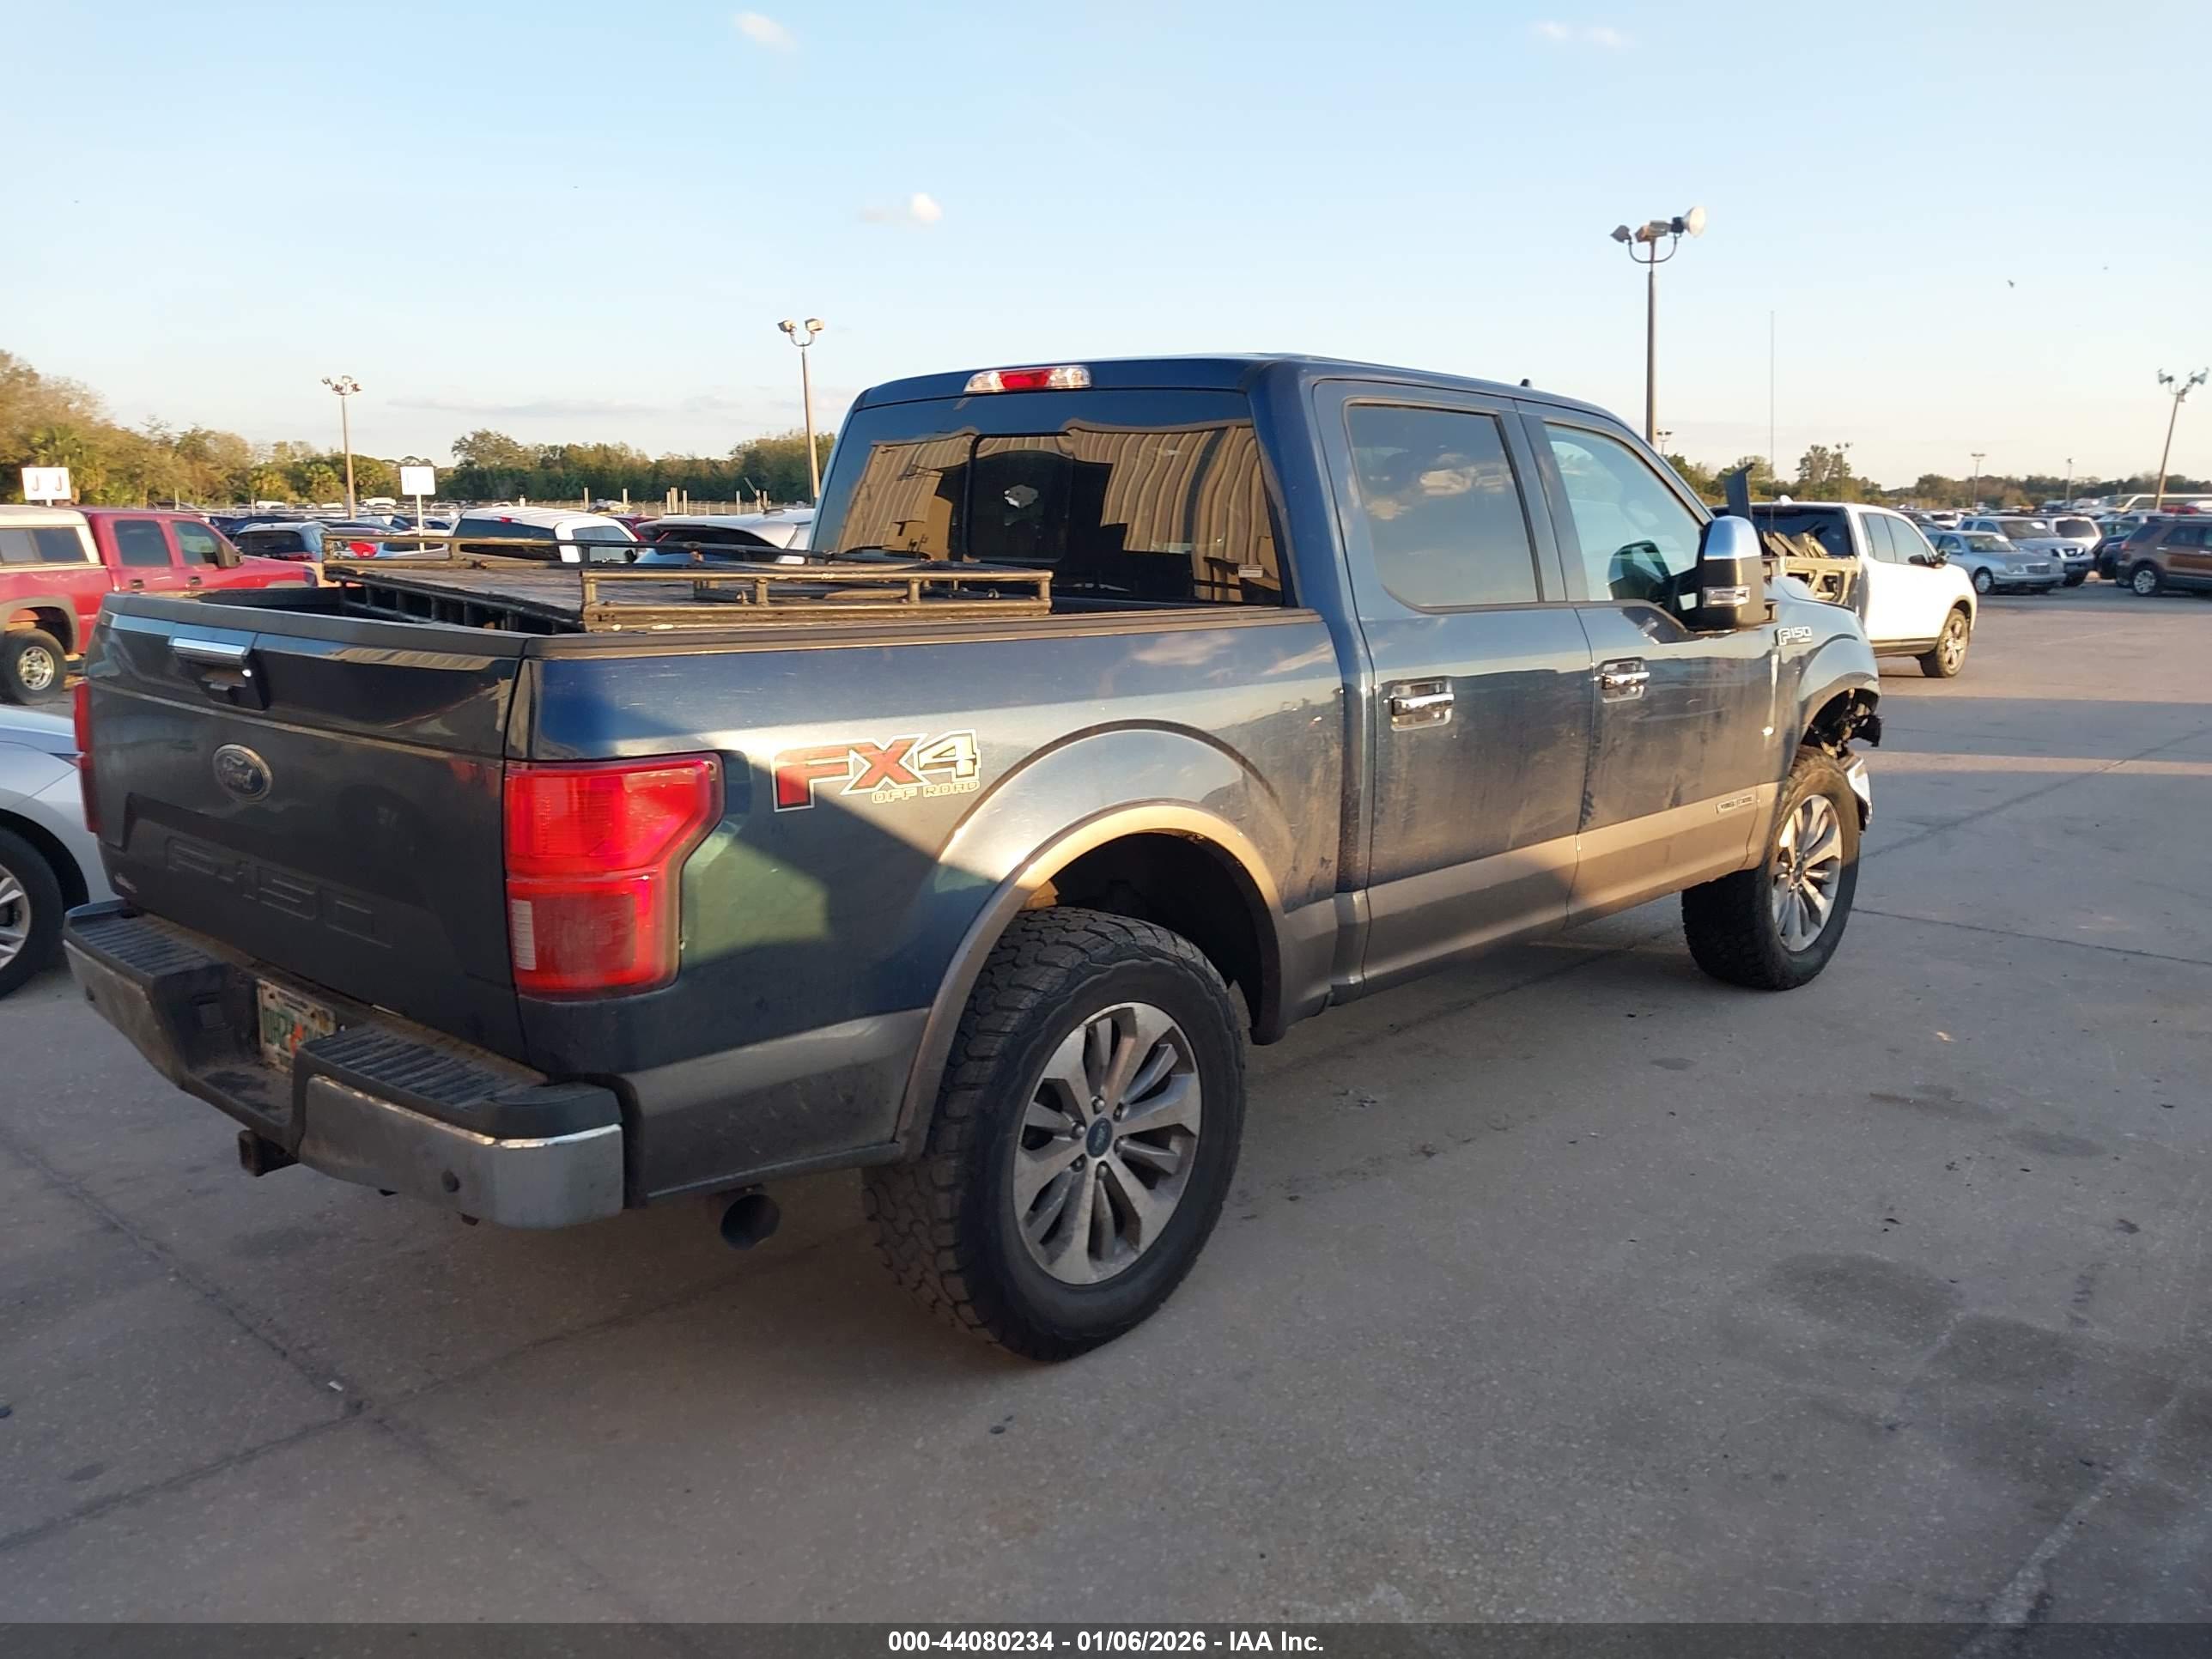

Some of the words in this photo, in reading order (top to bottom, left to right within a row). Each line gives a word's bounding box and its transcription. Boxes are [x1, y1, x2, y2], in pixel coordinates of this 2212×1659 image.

[772, 729, 981, 811] FX4
[872, 787, 917, 804] OFF
[923, 781, 980, 798] ROAD
